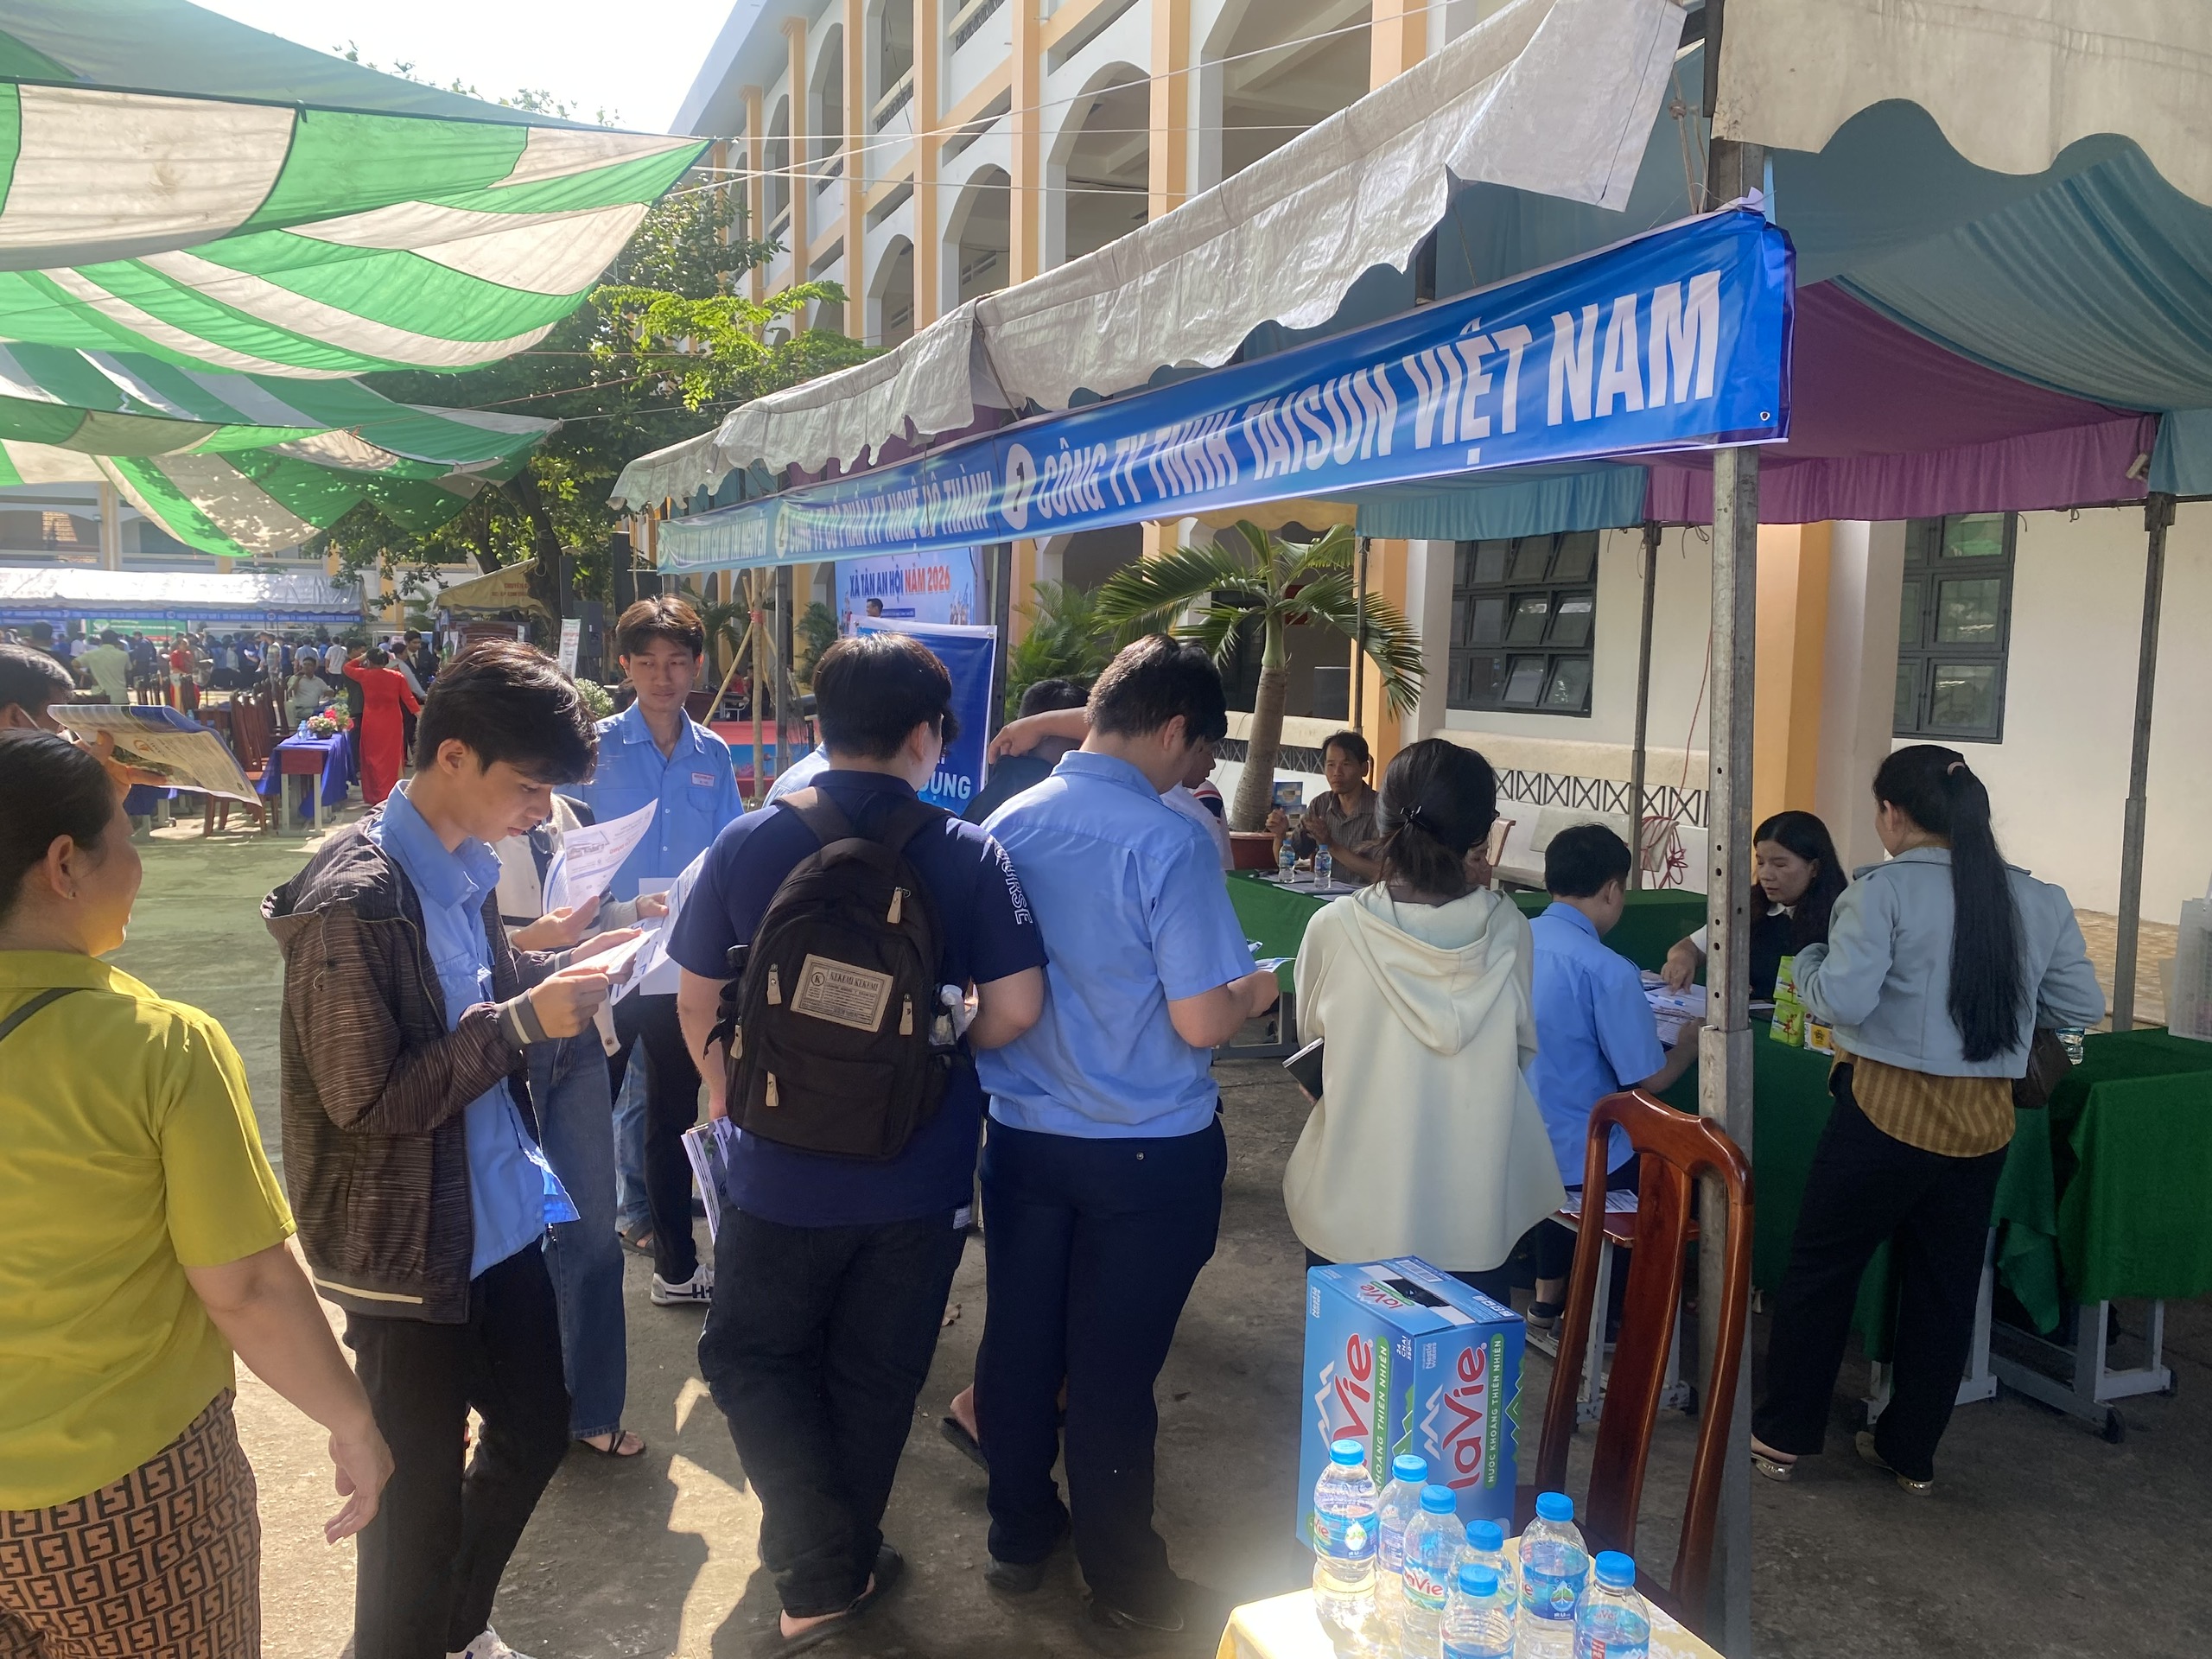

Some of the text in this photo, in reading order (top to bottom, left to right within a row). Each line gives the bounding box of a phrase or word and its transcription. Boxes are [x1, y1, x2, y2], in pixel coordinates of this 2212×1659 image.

[1011, 270, 1722, 519] 1 CÔNG TY TNHH TAISUN VIỆT NAM
[886, 476, 919, 550] NGHỆ
[942, 464, 992, 535] THÀNH
[876, 572, 888, 595] AN
[905, 563, 925, 594] NĂM
[1378, 1345, 1388, 1387] NHIÊN
[1491, 1340, 1501, 1371] NHIÊN
[1332, 1333, 1372, 1442] Vie
[1491, 1375, 1500, 1405] THIÊN
[1489, 1408, 1498, 1451] KHOÁNG
